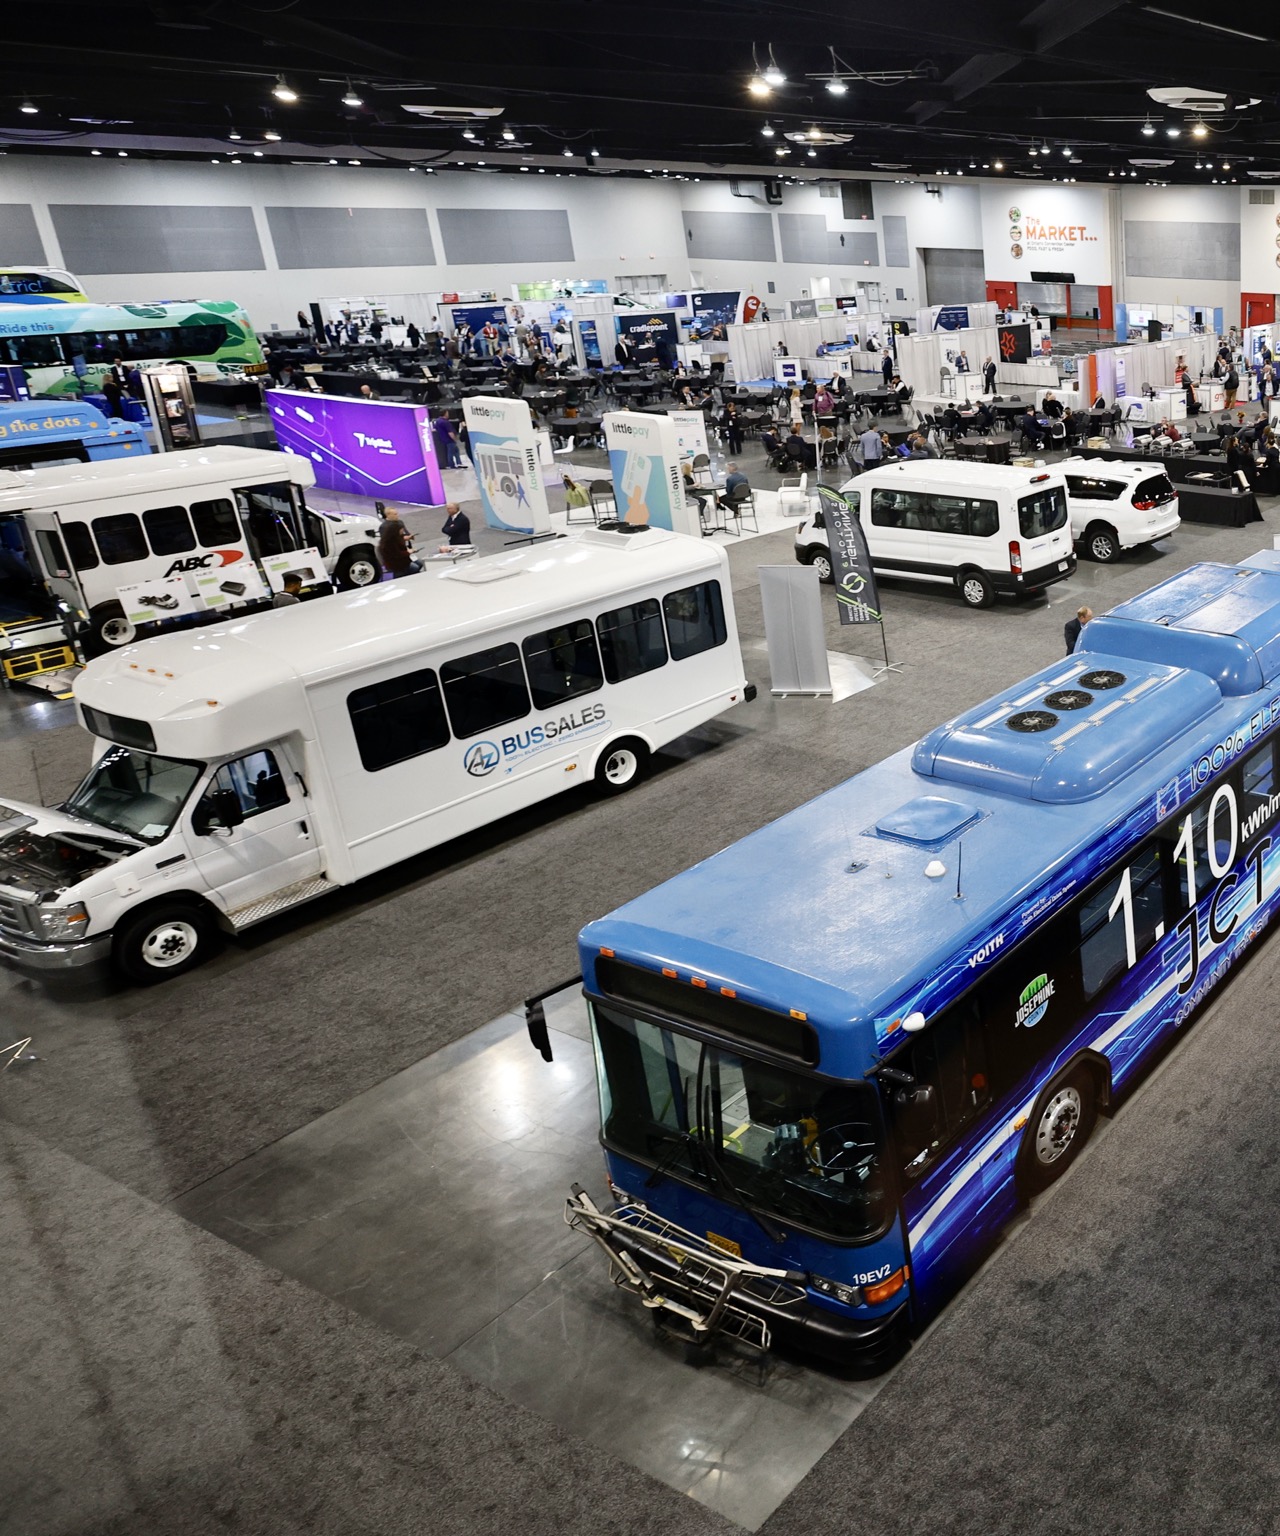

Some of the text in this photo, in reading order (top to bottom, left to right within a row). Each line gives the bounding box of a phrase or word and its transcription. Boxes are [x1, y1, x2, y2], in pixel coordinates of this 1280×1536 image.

[1025, 226, 1097, 241] MARKET...
[1026, 216, 1040, 225] The
[0, 322, 54, 334] Ride this
[630, 323, 668, 334] cradlepoint
[10, 419, 39, 433] the
[43, 417, 81, 430] dots
[470, 406, 506, 421] littlepay
[612, 422, 650, 439] littlepay
[526, 448, 538, 491] littlepay
[670, 465, 682, 511] littlepay
[162, 554, 214, 578] ABC
[524, 741, 554, 756] ELECTRIC
[558, 732, 574, 743] ZERO
[574, 720, 607, 736] EMISSIONS
[1190, 731, 1244, 792] 100%
[1108, 784, 1238, 968] 1.10
[1177, 837, 1272, 995] JCT
[968, 932, 1004, 968] VOITH
[1174, 908, 1270, 1027] COMMUNITY TRANSIT
[1014, 979, 1056, 1028] JOSEPHINE
[852, 1264, 891, 1286] 19EV2
